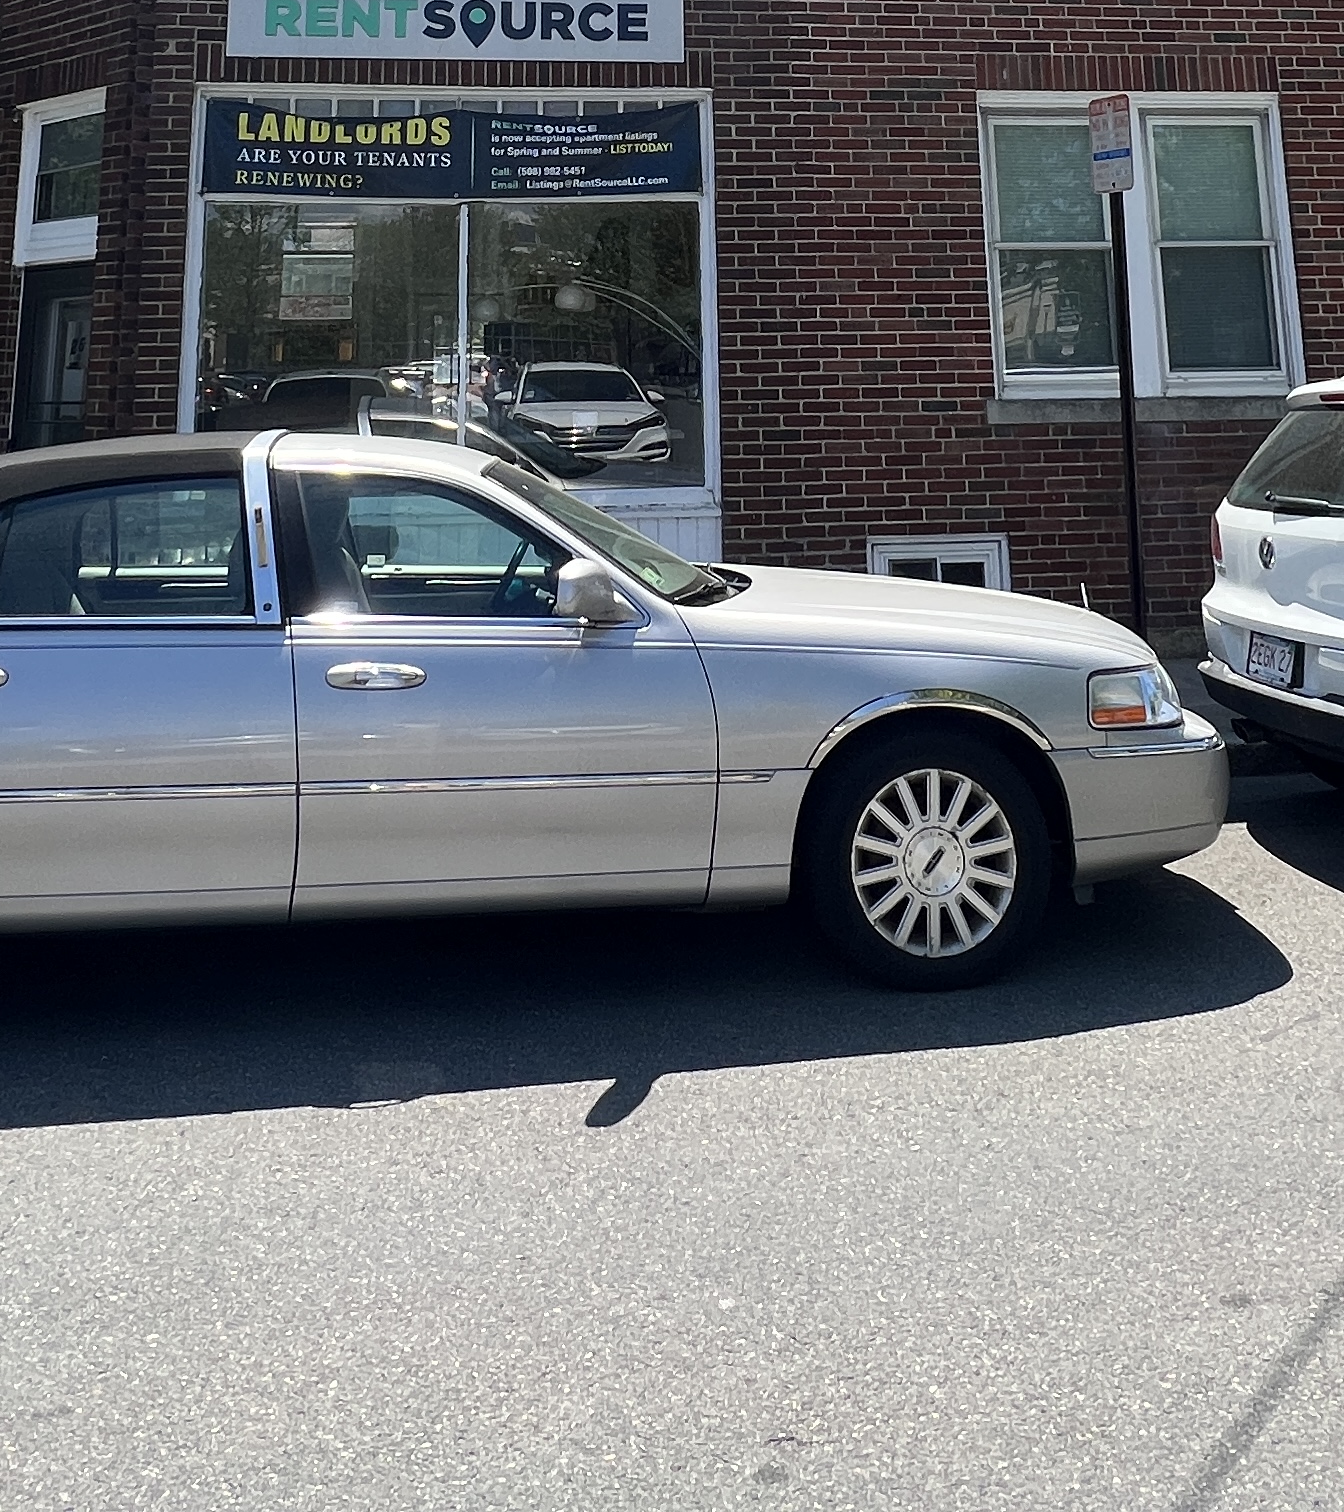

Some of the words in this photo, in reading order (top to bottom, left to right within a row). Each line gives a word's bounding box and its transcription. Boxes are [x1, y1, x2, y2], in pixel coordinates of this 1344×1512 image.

[237, 112, 451, 146] LANDLORDS
[491, 120, 598, 134] RENTSOURCE
[491, 134, 500, 143] is
[502, 135, 524, 143] now
[526, 134, 572, 144] accepting
[574, 132, 623, 143] apartment
[625, 131, 658, 142] listings
[237, 148, 281, 163] ARE
[288, 150, 347, 166] YOUR
[354, 152, 452, 168] TENANTS
[491, 147, 504, 156] for
[507, 146, 538, 158] Spring
[540, 146, 560, 156] and
[562, 146, 602, 156] Summer
[610, 144, 632, 154] LIST
[632, 142, 674, 154] TODAY!
[235, 170, 364, 189] RENEWING?
[1278, 649, 1293, 674] 27
